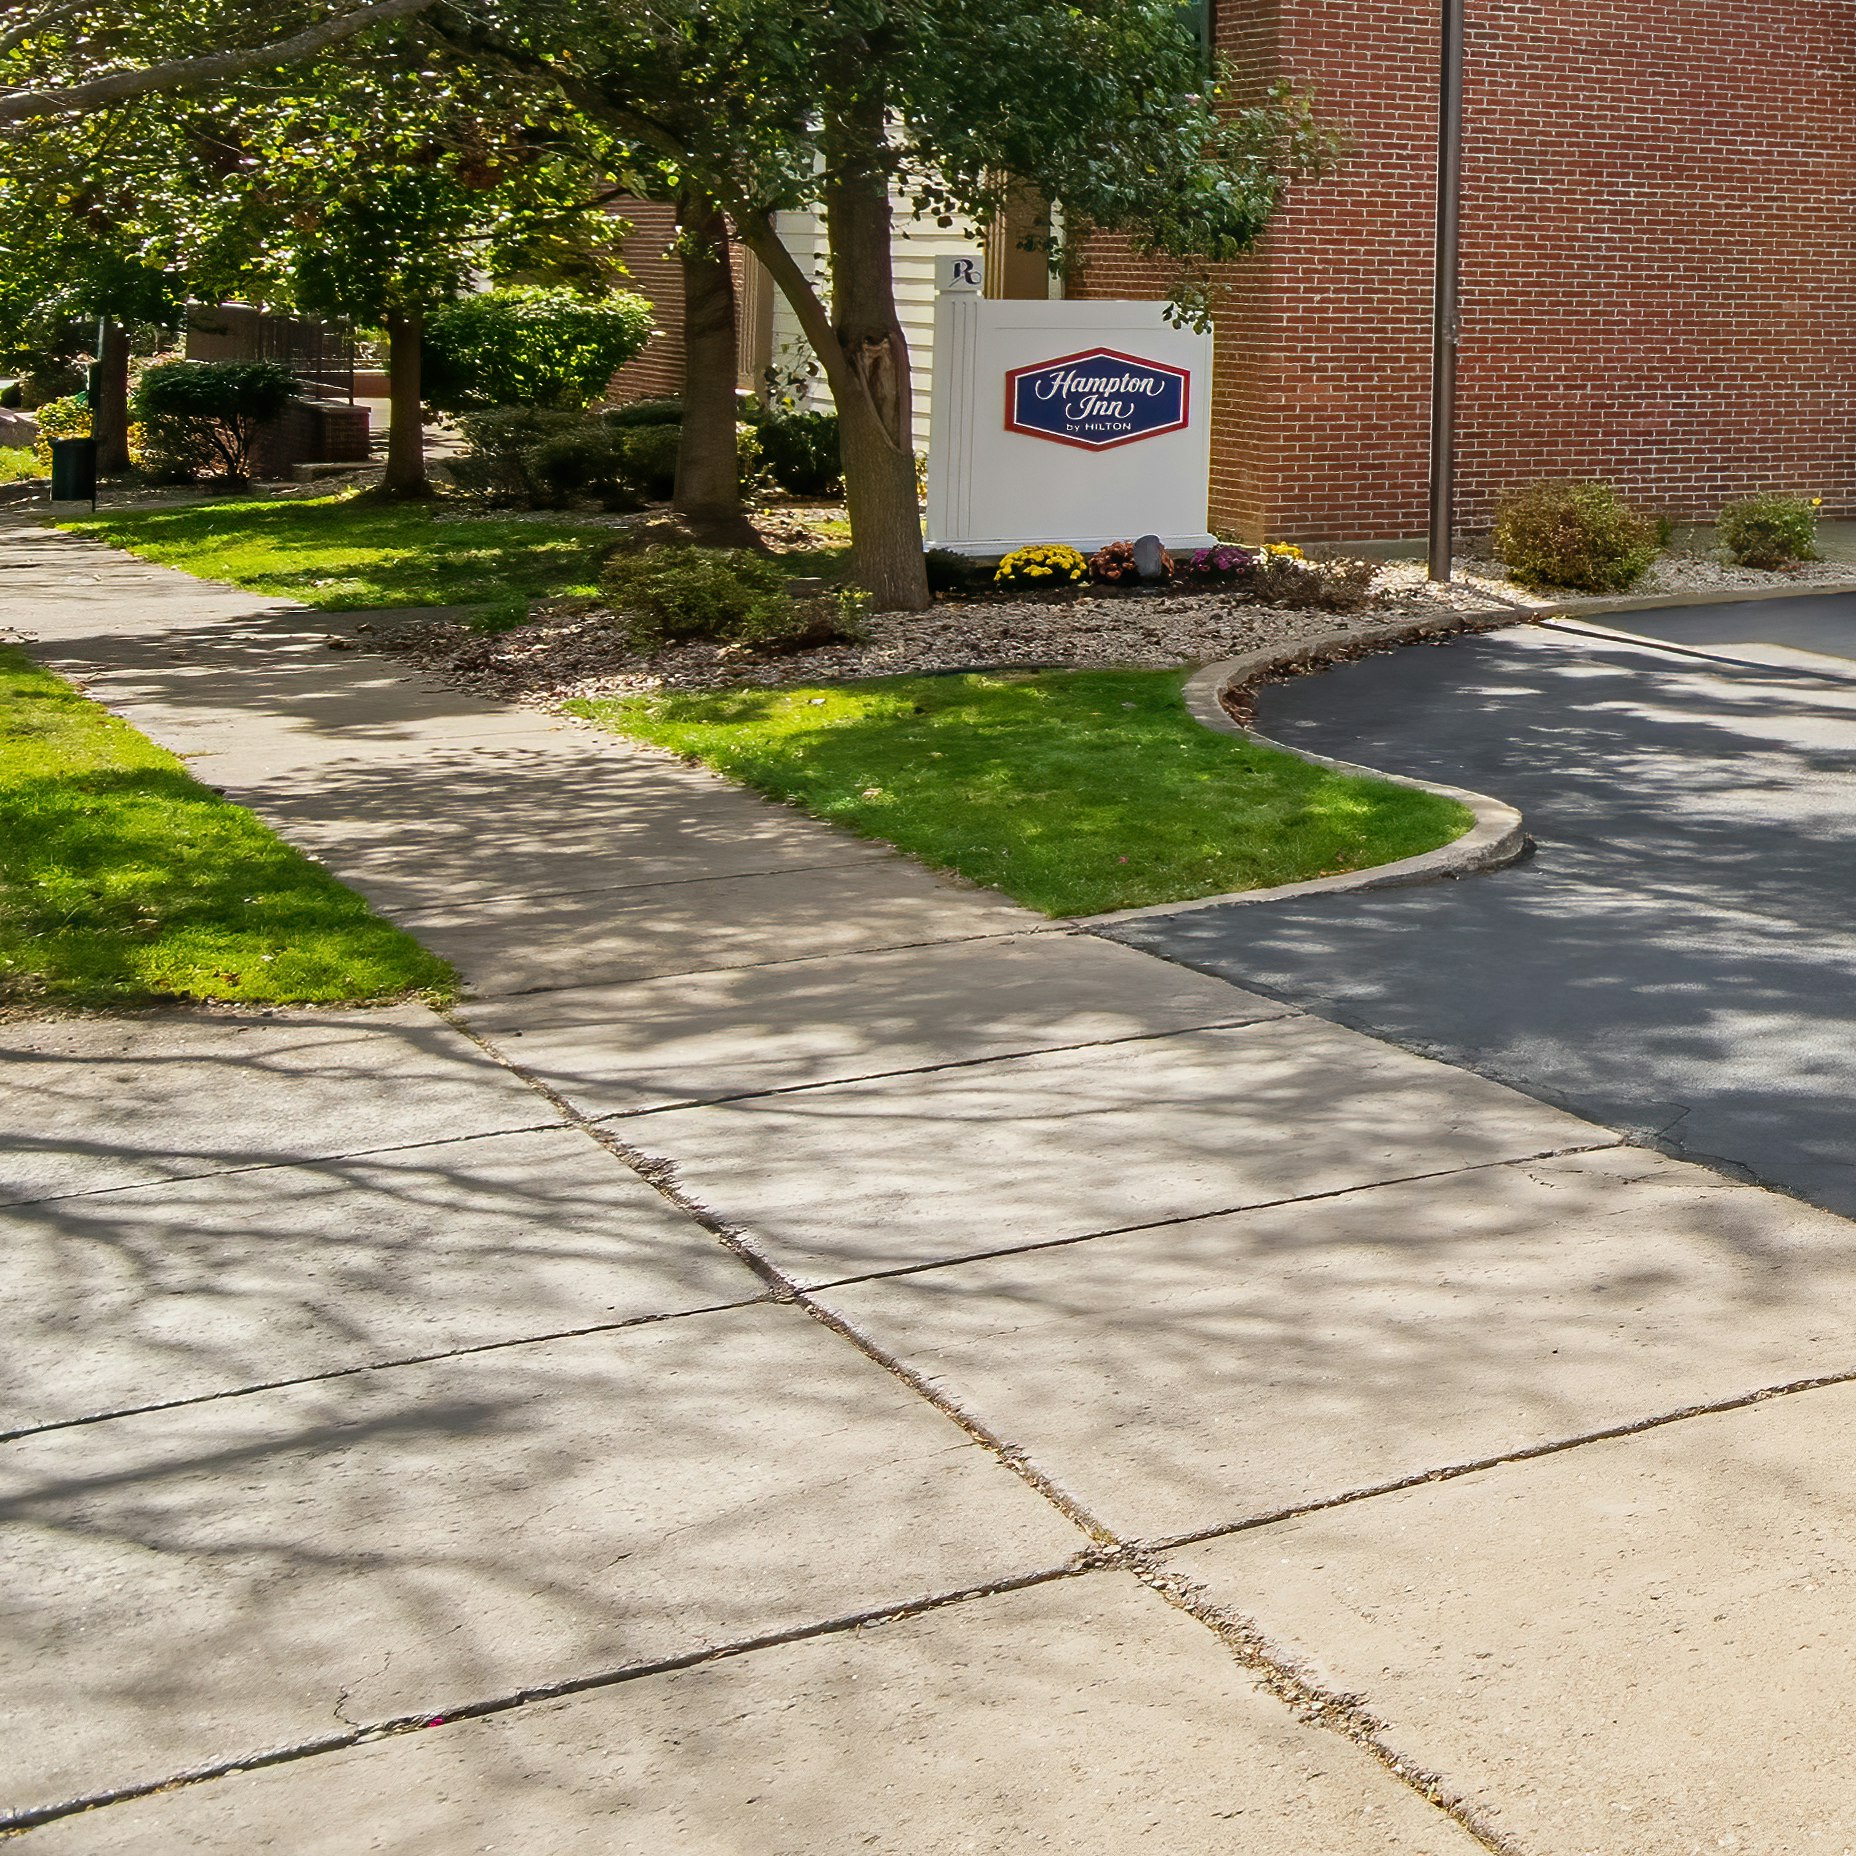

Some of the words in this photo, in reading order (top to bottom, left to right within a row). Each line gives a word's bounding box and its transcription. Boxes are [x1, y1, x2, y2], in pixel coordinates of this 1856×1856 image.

[1035, 369, 1165, 400] Hampton
[1065, 394, 1135, 420] Inn
[1066, 423, 1080, 432] by
[1085, 422, 1132, 432] HILTON
